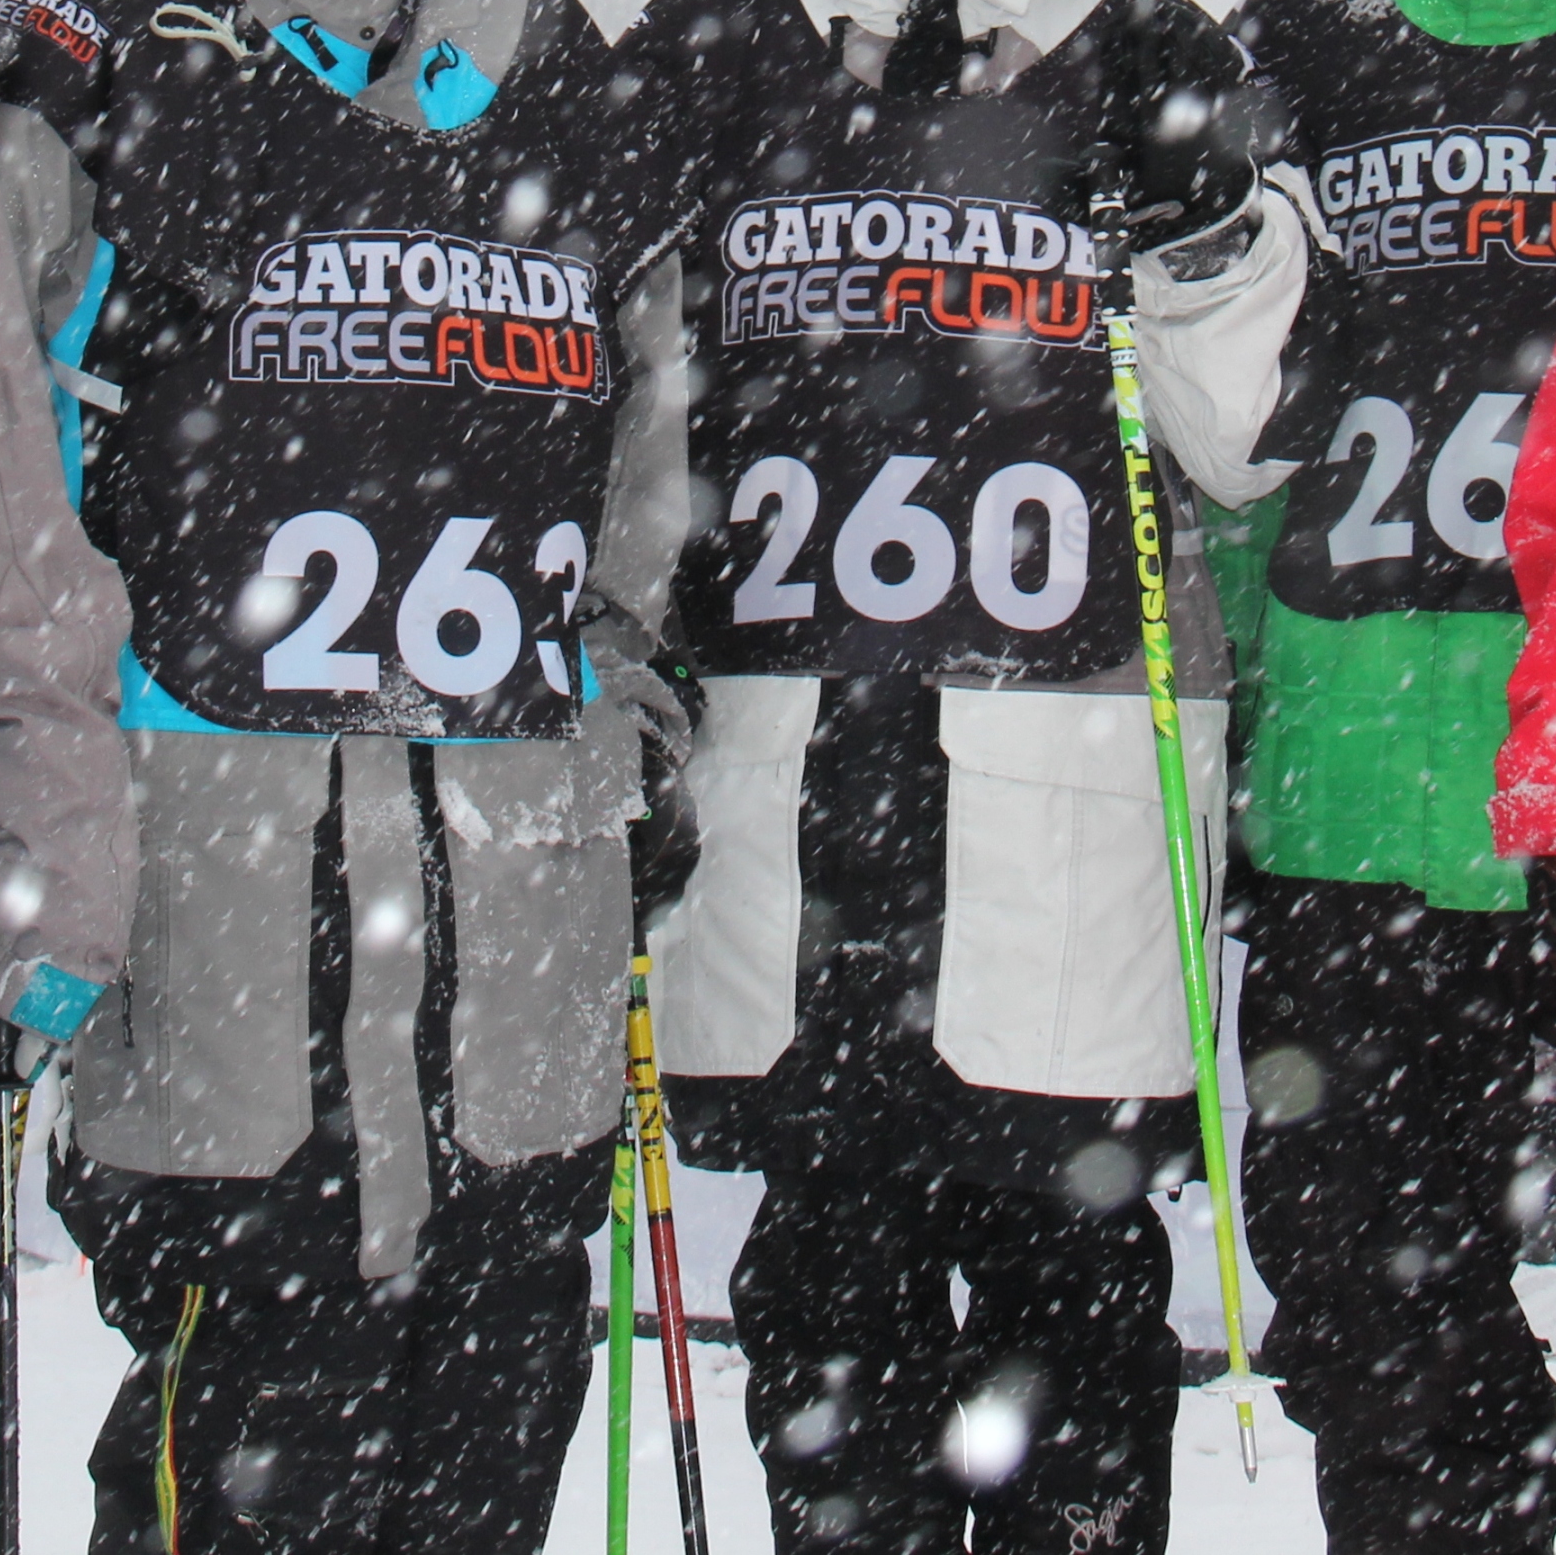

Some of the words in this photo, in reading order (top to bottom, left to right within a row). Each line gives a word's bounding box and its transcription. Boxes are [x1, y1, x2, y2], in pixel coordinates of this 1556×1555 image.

[1329, 198, 1461, 271] REE
[248, 241, 599, 327] GATORADE
[730, 265, 880, 334] FREE
[883, 266, 1092, 339] FLOW
[239, 309, 433, 373] FREE
[435, 316, 594, 389] FLOW
[1325, 392, 1527, 567] 26
[728, 455, 1091, 631] 260
[1125, 448, 1167, 624] SCOTT
